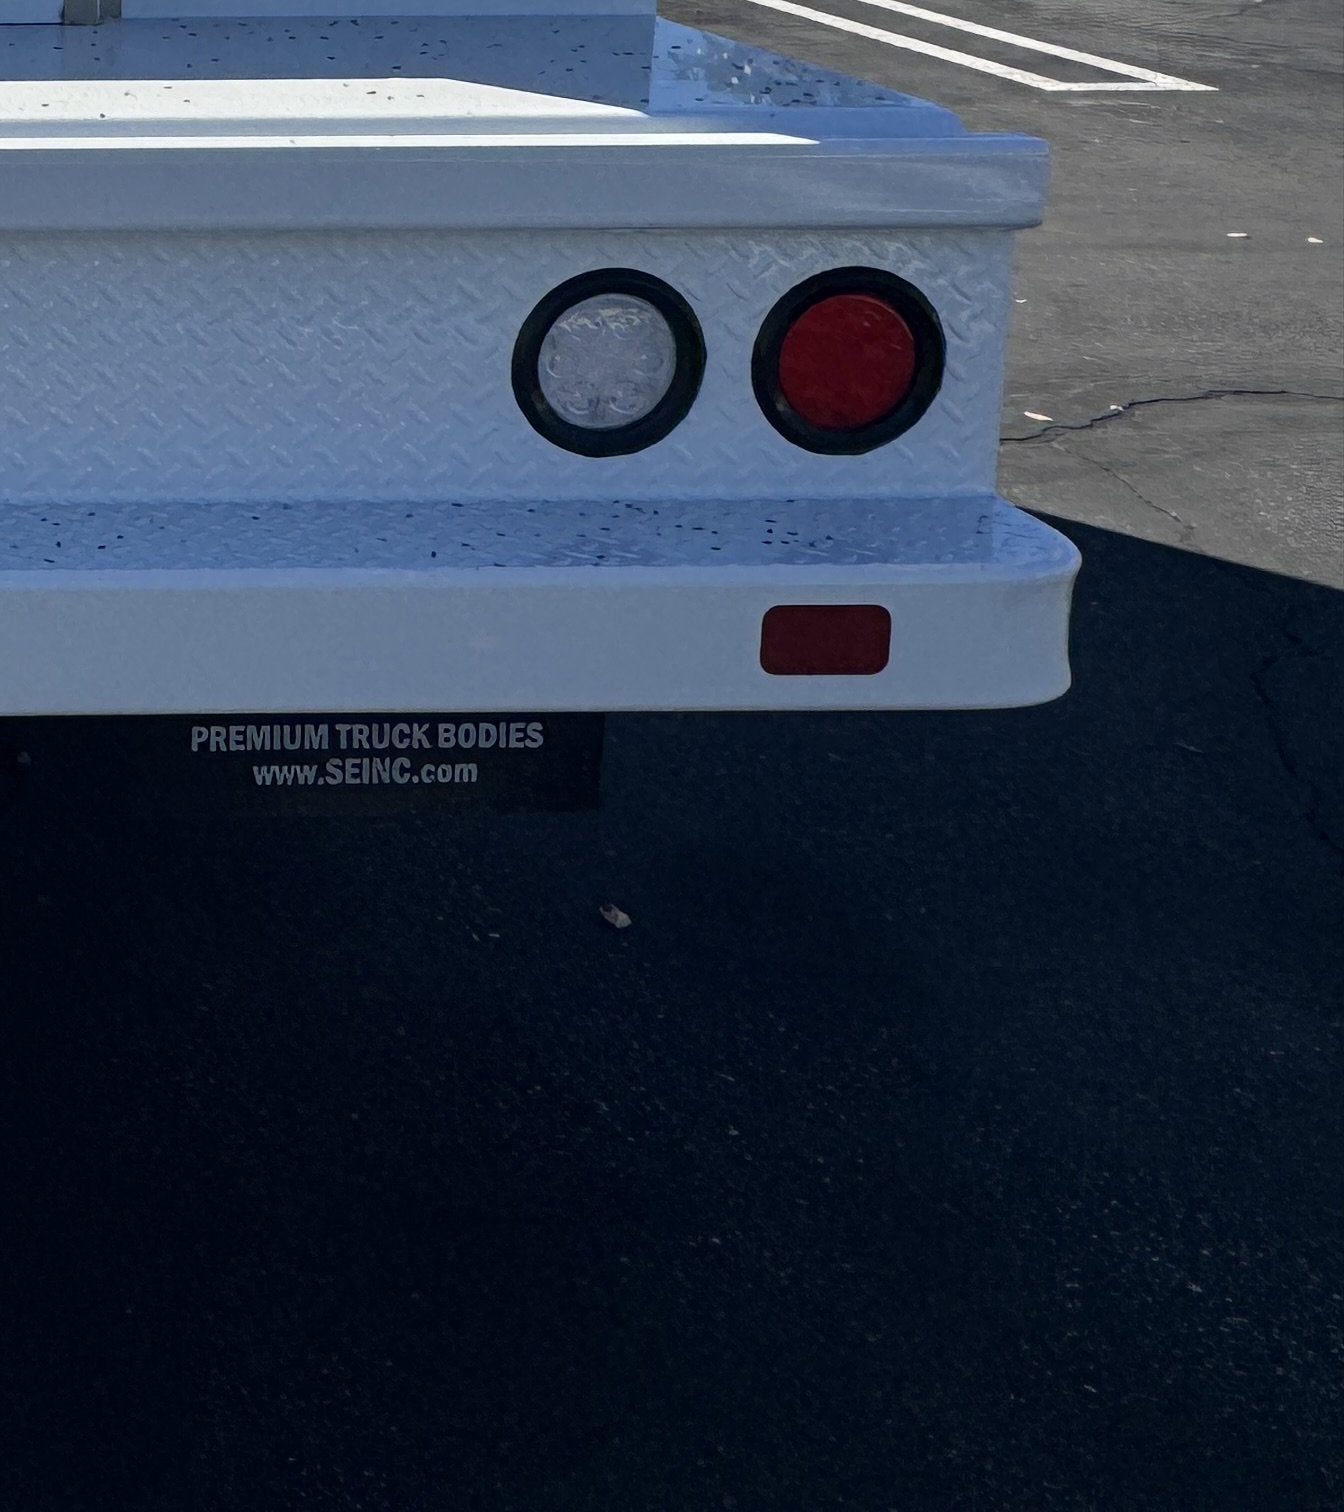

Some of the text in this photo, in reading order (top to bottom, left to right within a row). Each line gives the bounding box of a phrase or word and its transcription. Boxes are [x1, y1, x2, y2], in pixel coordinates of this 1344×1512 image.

[191, 722, 544, 752] PREMIUM TRUCK BODIES
[253, 757, 478, 785] www.SEINC.com
